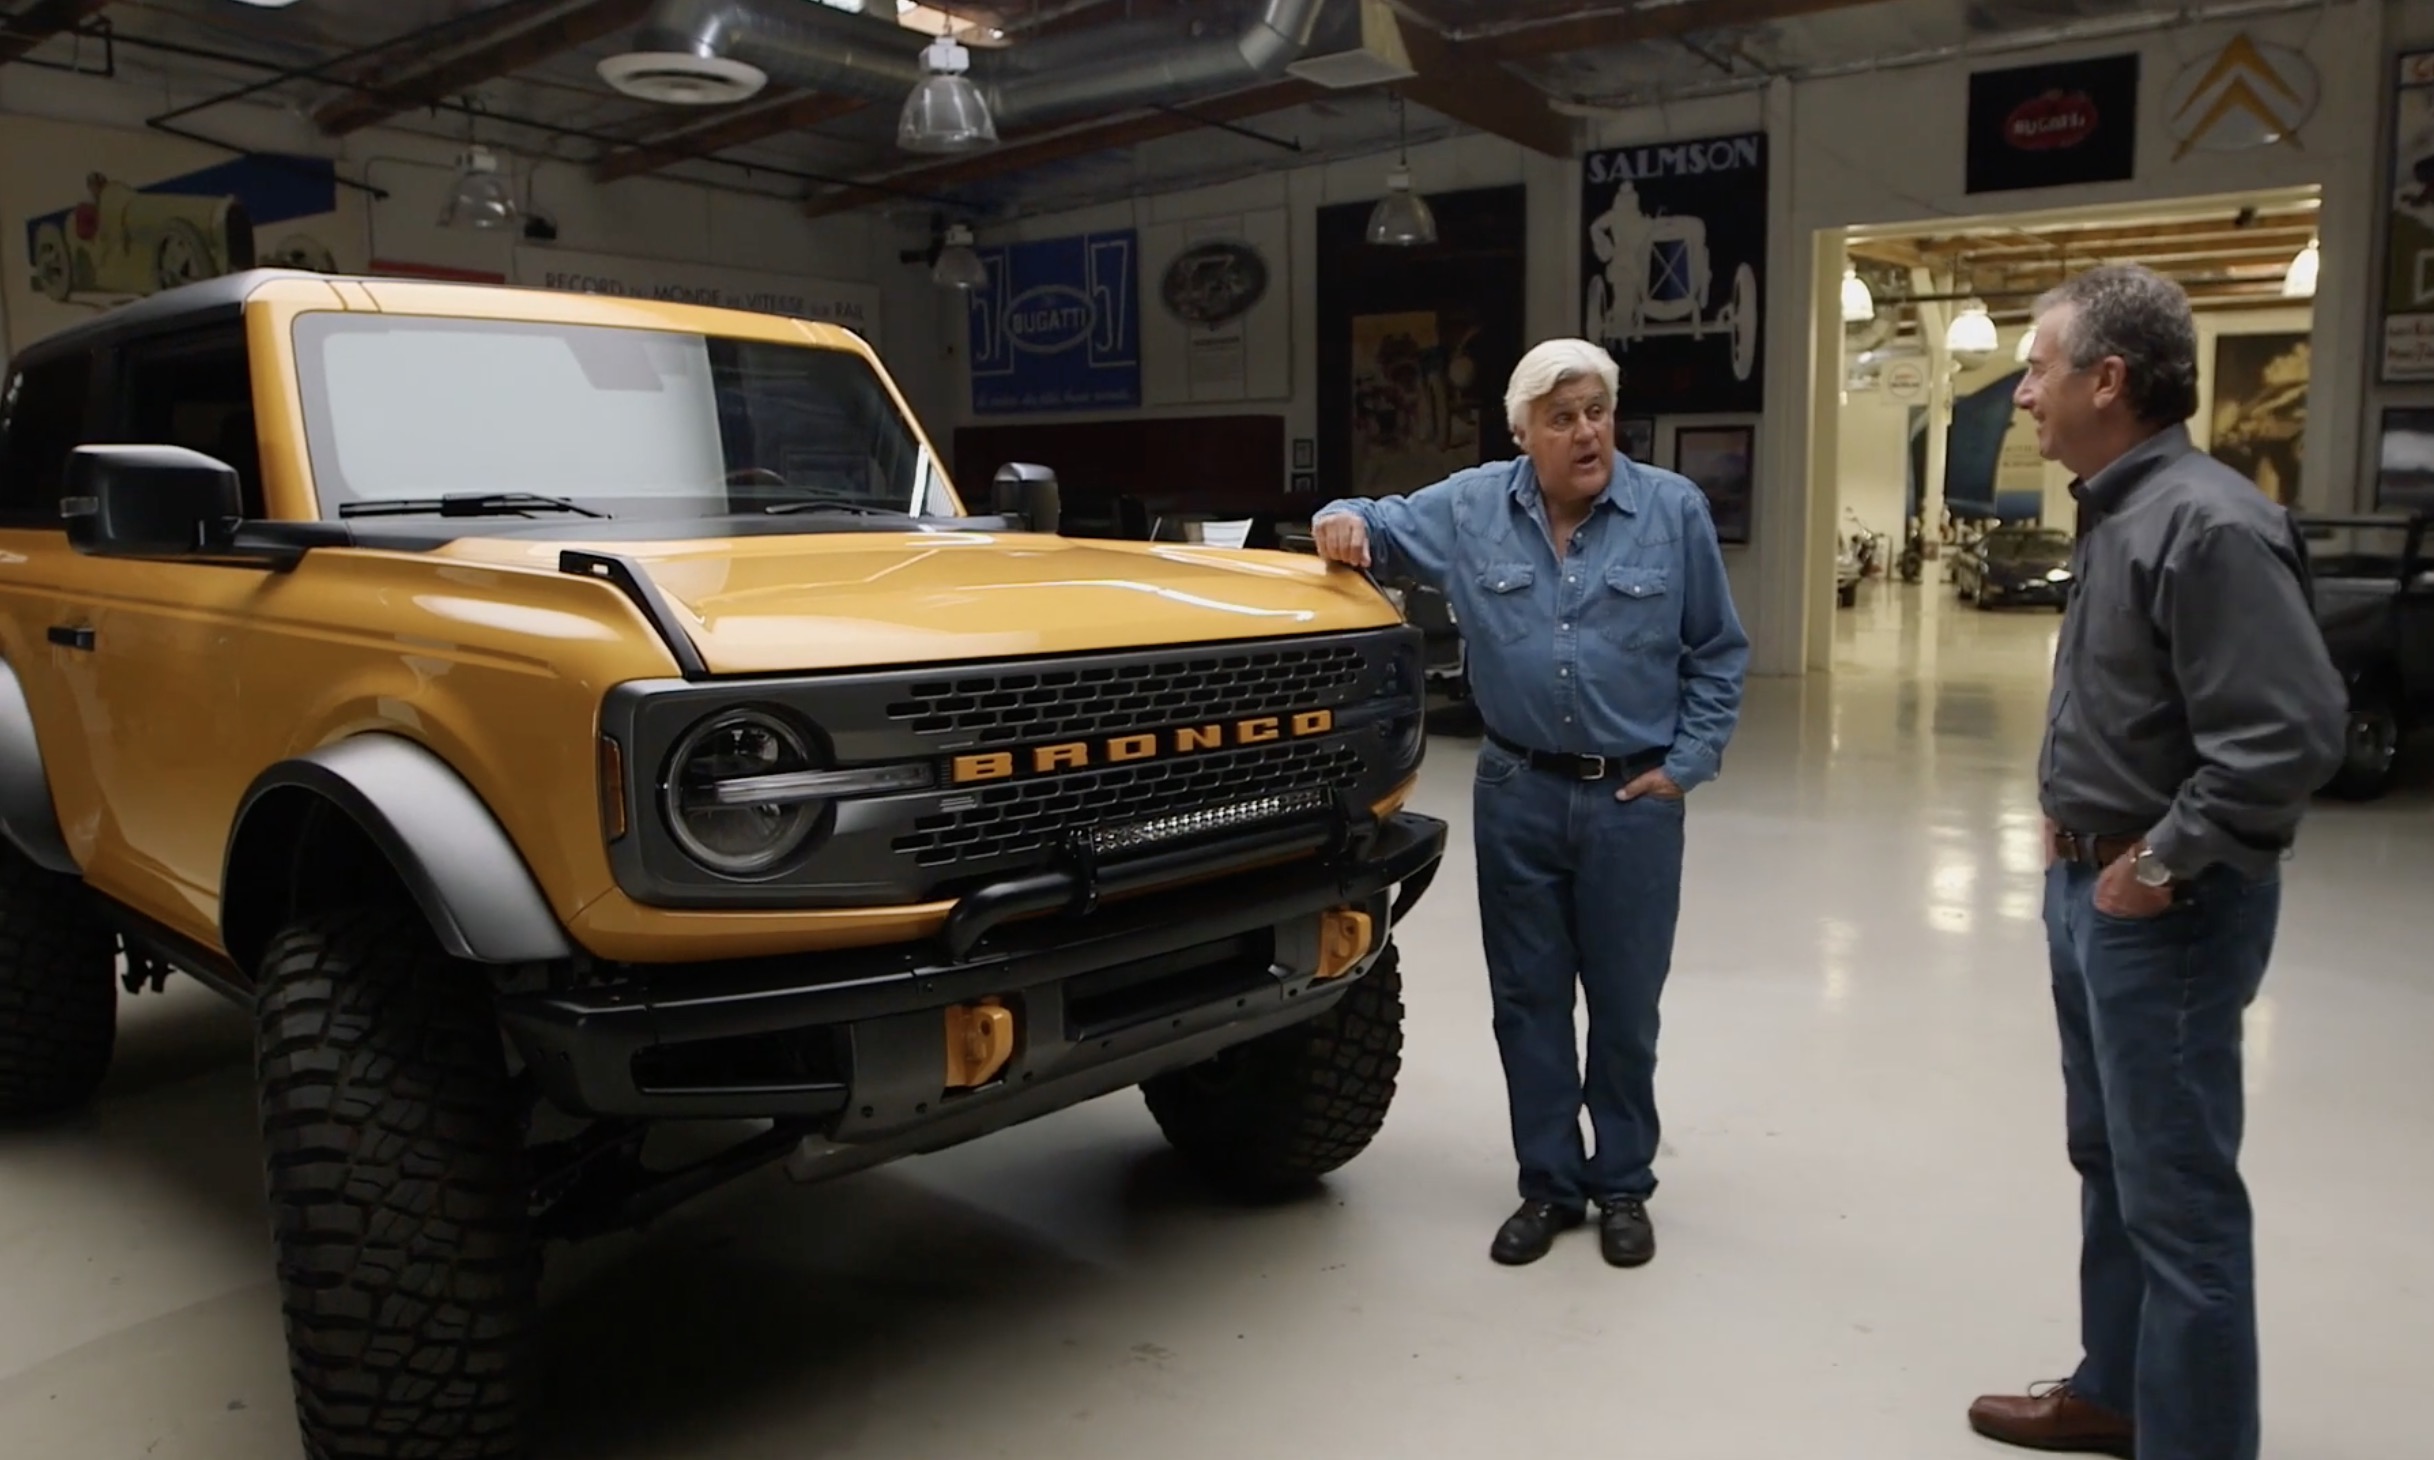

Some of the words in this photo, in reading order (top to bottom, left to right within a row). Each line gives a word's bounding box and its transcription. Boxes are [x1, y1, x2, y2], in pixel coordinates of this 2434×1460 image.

[1588, 135, 1759, 184] SALMSON
[546, 272, 625, 294] RECORD
[654, 285, 719, 306] MONDE
[1090, 239, 1129, 352] 57
[1011, 308, 1087, 335] BUGATTI
[951, 709, 1334, 784] BRONCO
